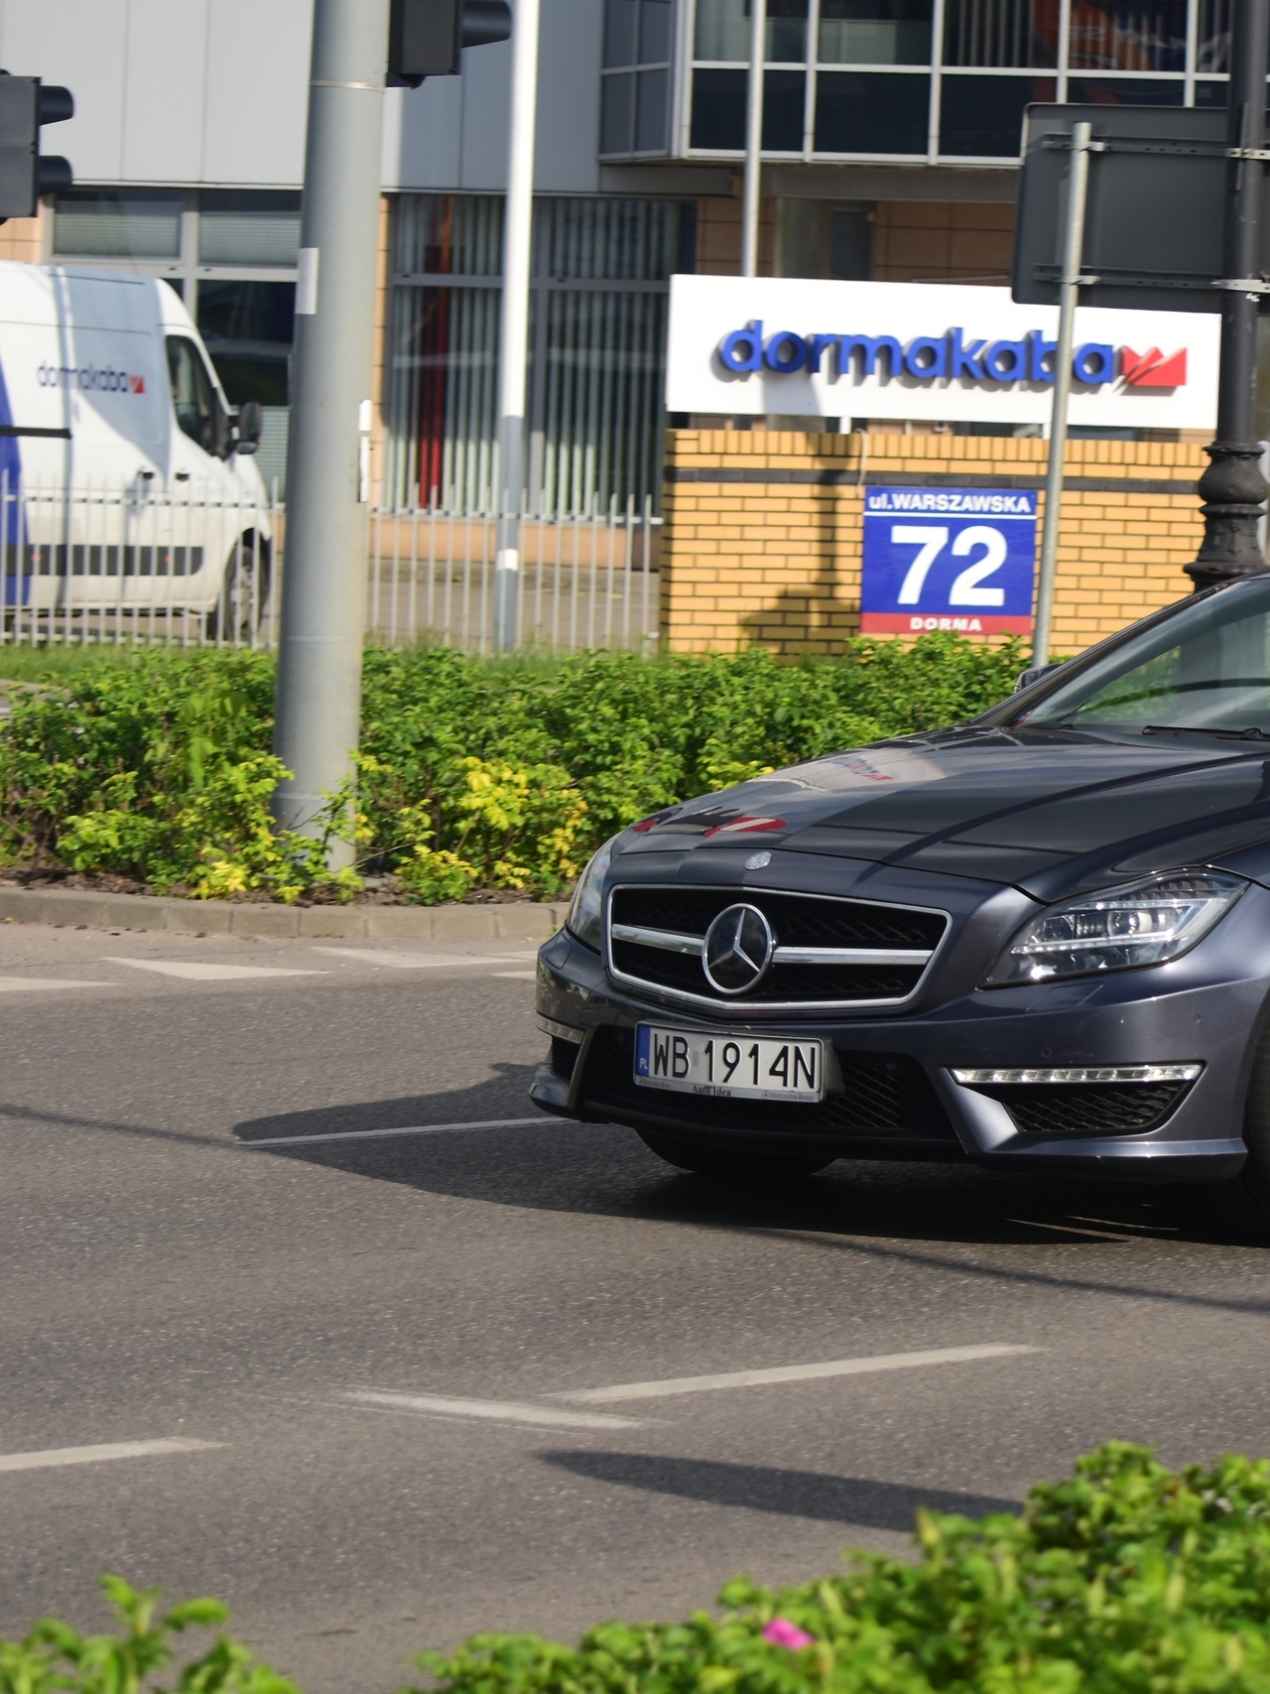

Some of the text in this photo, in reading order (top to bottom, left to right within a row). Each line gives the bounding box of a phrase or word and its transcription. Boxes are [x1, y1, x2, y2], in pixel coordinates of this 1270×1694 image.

[720, 319, 1114, 384] dormakaba
[37, 360, 128, 392] dormakaba
[891, 525, 1007, 606] 72
[909, 617, 983, 632] DORMA
[639, 1057, 648, 1070] PL
[654, 1033, 816, 1089] WB 1914N
[692, 1085, 732, 1097] Auto Idea
